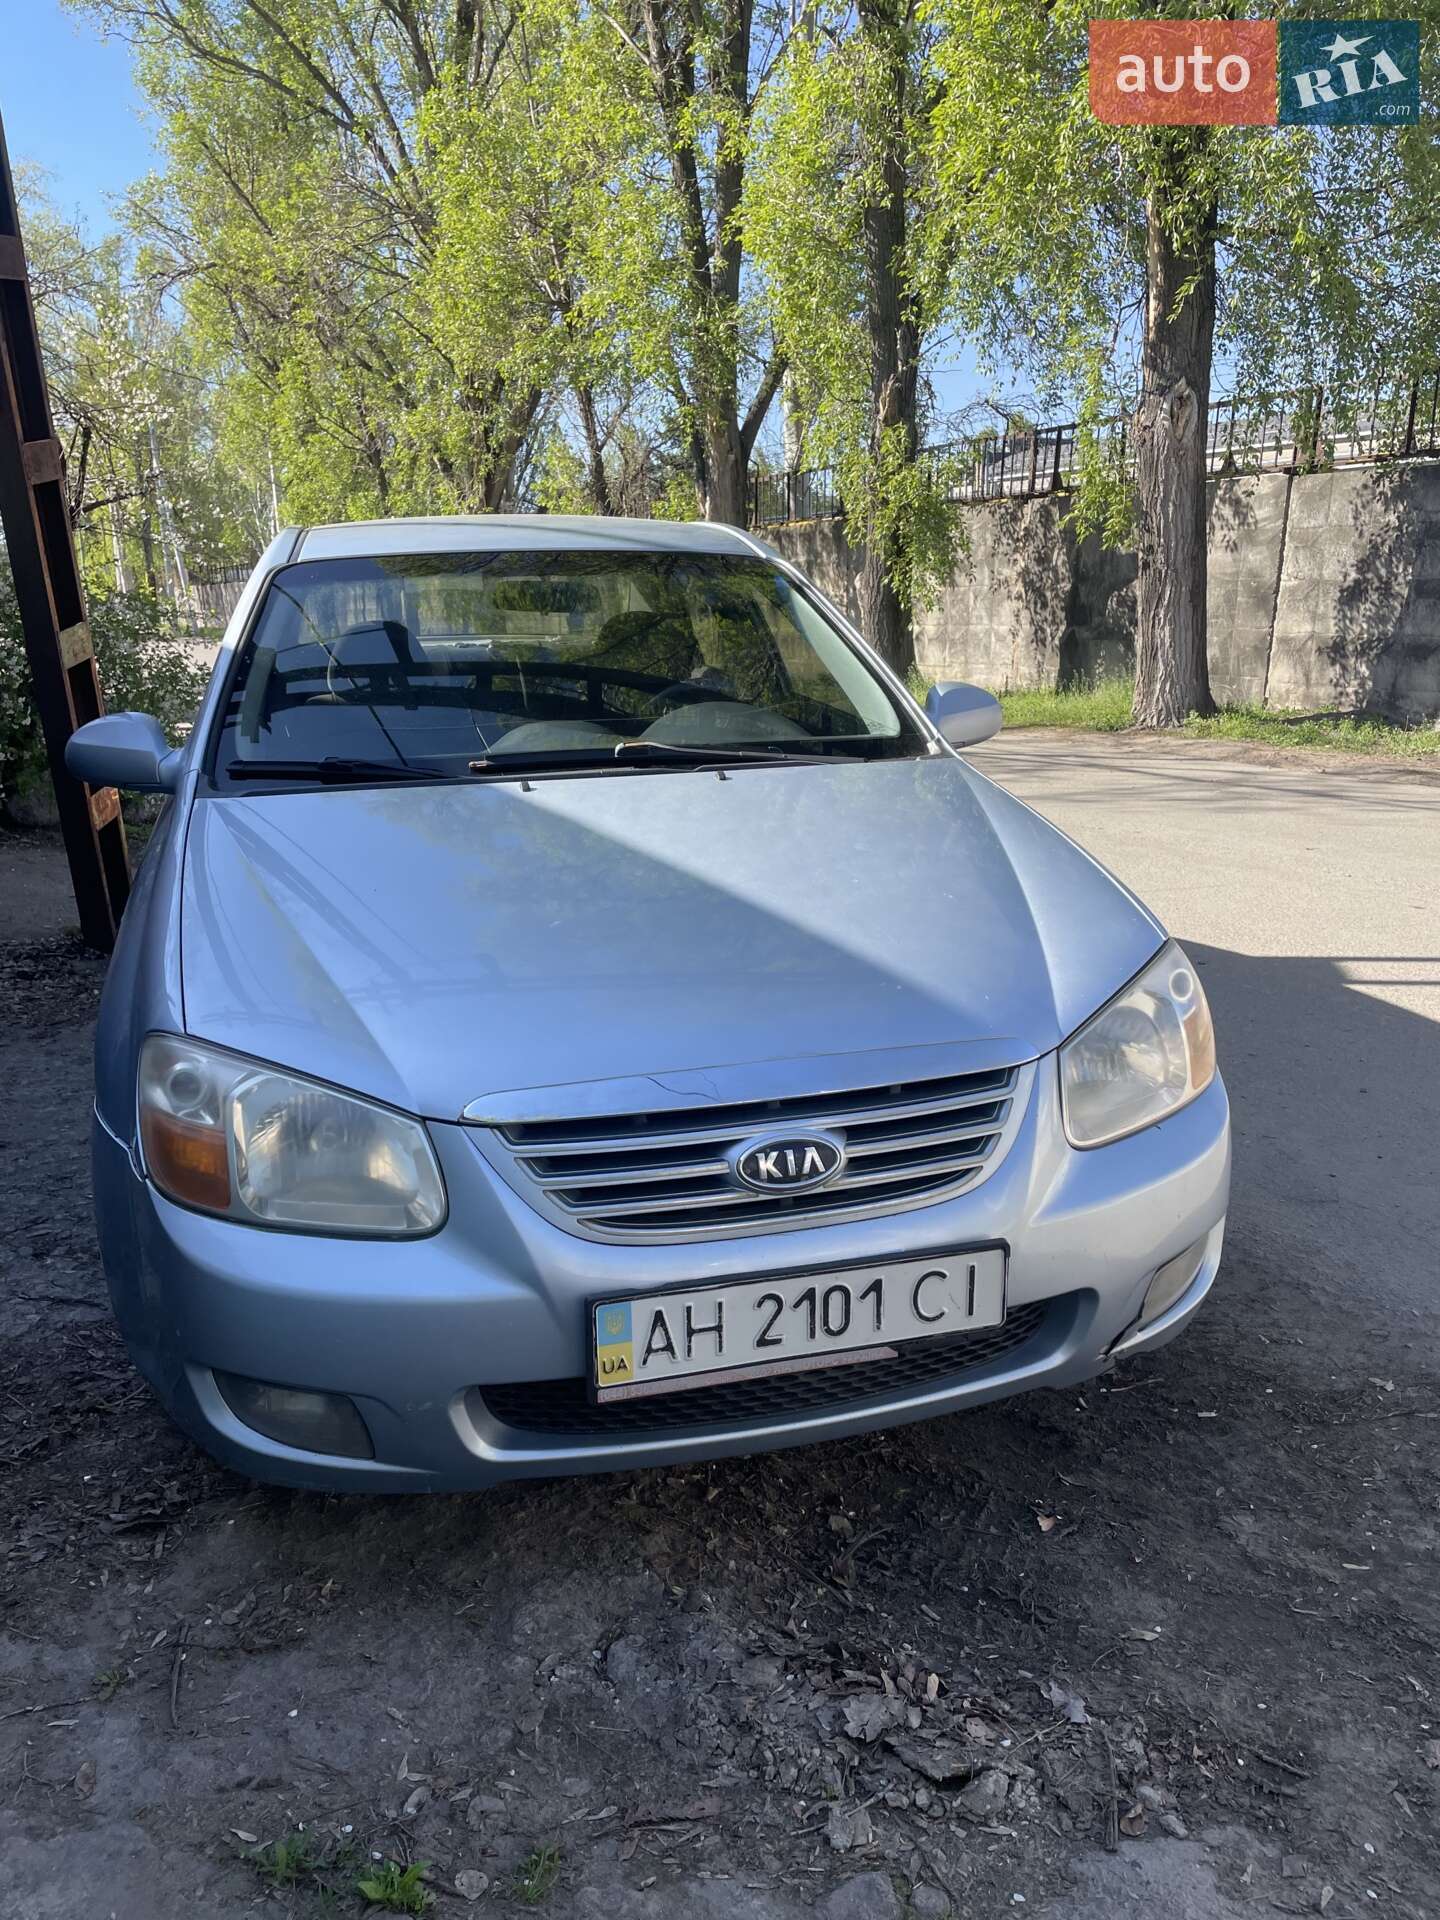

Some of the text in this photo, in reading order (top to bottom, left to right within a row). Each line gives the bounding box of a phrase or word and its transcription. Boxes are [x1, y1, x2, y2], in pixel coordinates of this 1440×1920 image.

[755, 1146, 826, 1180] KIA
[641, 1264, 977, 1366] AH 2101 CI
[602, 1357, 630, 1374] UA
